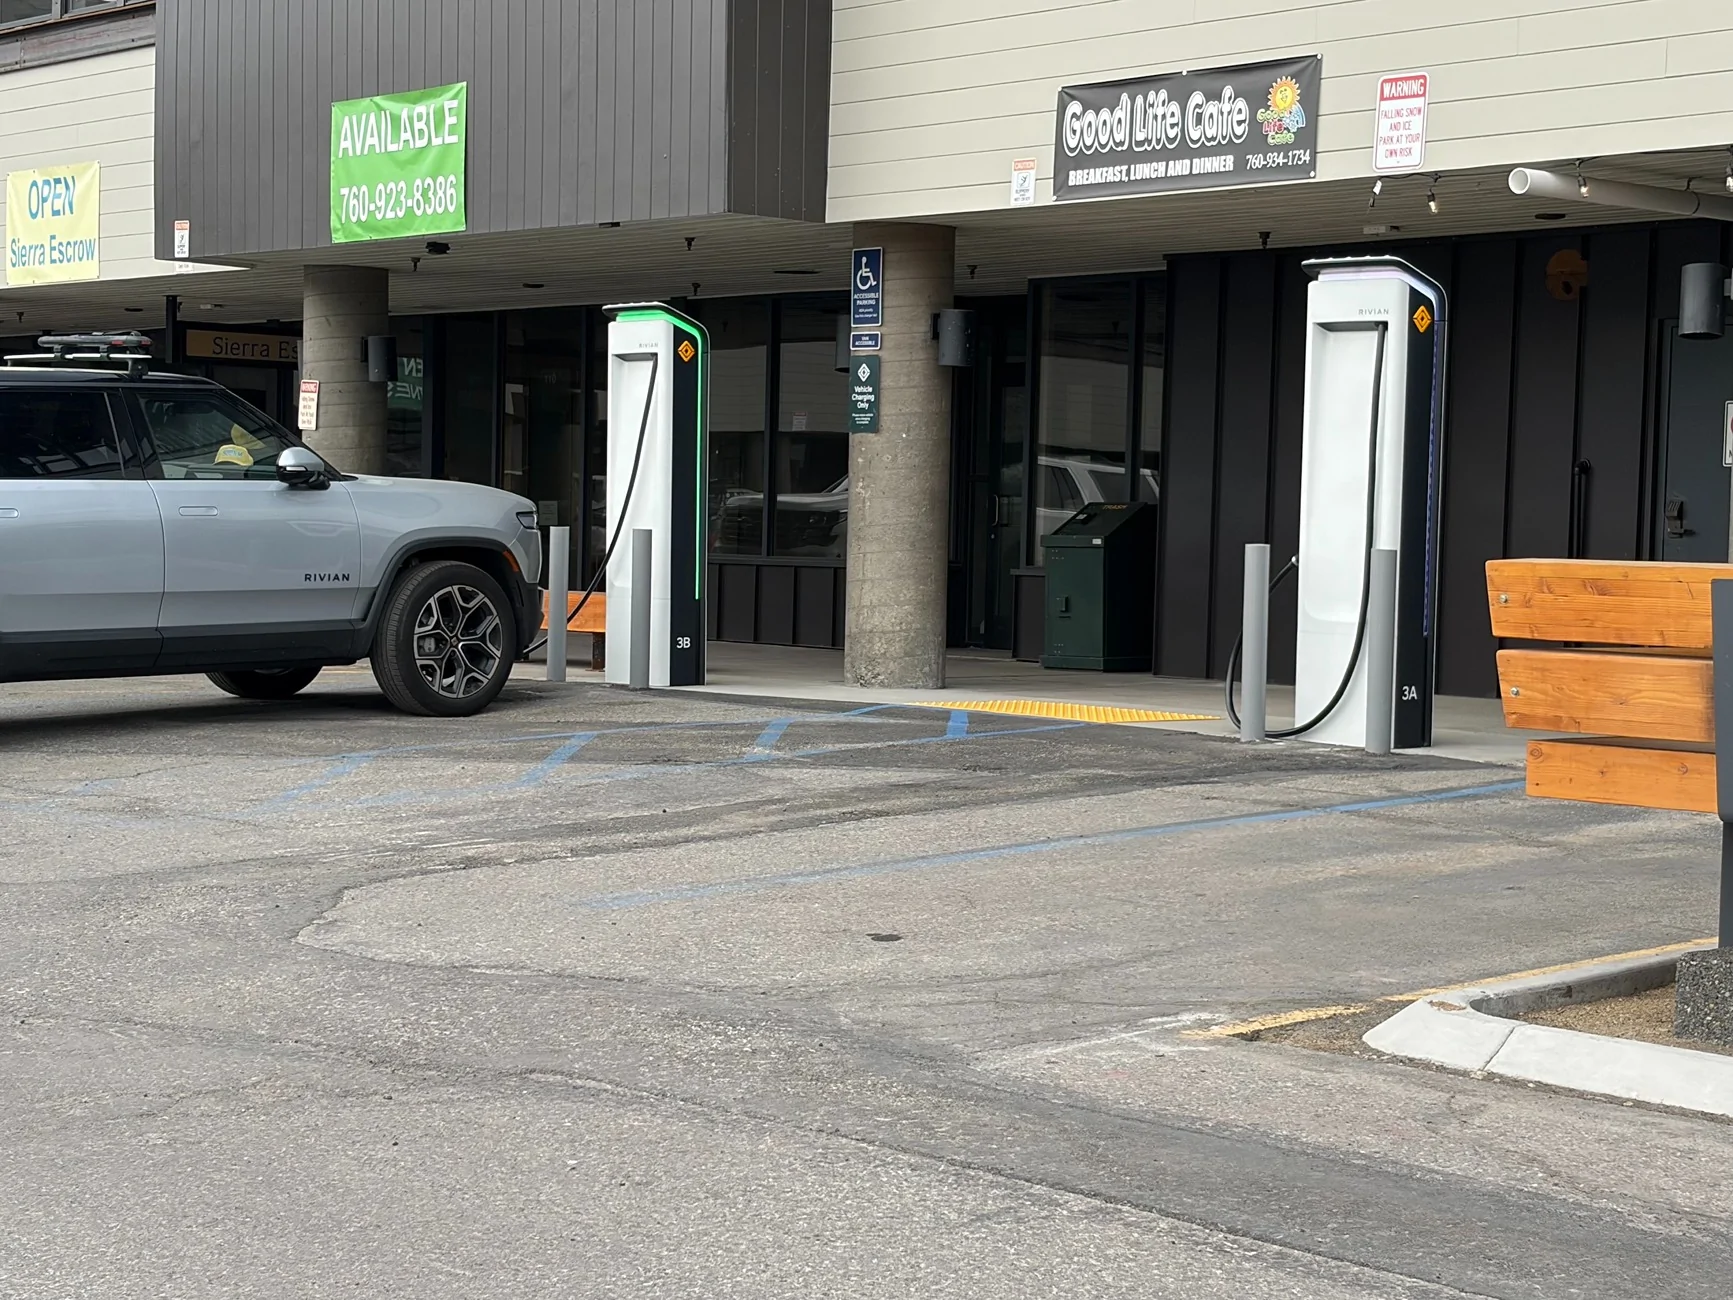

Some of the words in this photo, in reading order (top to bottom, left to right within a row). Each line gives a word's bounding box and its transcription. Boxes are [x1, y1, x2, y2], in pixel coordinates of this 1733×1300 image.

[1383, 79, 1425, 98] WARNING
[1380, 108, 1404, 119] FALLING
[1405, 106, 1422, 118] SNOW
[338, 99, 459, 159] AVAILABLE
[1063, 92, 1130, 157] Good
[1132, 89, 1181, 152] Life
[1184, 85, 1250, 149] Cafe
[1262, 119, 1285, 135] Life
[1389, 121, 1401, 132] AND
[1402, 120, 1412, 131] ICE
[1267, 130, 1295, 146] Cafe
[1379, 136, 1394, 146] PARK
[1395, 134, 1403, 145] AT
[1405, 133, 1421, 144] YOUR
[1245, 149, 1311, 170] 760-934-1734
[1384, 148, 1398, 159] OWN
[1399, 147, 1413, 157] RISK
[1068, 165, 1128, 186] BREAKFAST,
[1129, 161, 1166, 181] LUNCH
[1166, 158, 1191, 177] AND
[1191, 154, 1234, 175] DINNER
[28, 175, 76, 220] OPEN
[339, 174, 458, 224] 760-923-8386
[10, 237, 46, 268] Sierra
[49, 234, 96, 265] Escrow
[1358, 307, 1389, 316] RIVIAN
[212, 336, 269, 358] Sierra
[854, 385, 873, 393] Vehicle
[851, 393, 875, 402] Charging
[856, 401, 870, 410] Only
[304, 573, 350, 582] RIVIAN
[676, 636, 691, 649] 3B
[1401, 685, 1418, 701] 3A
